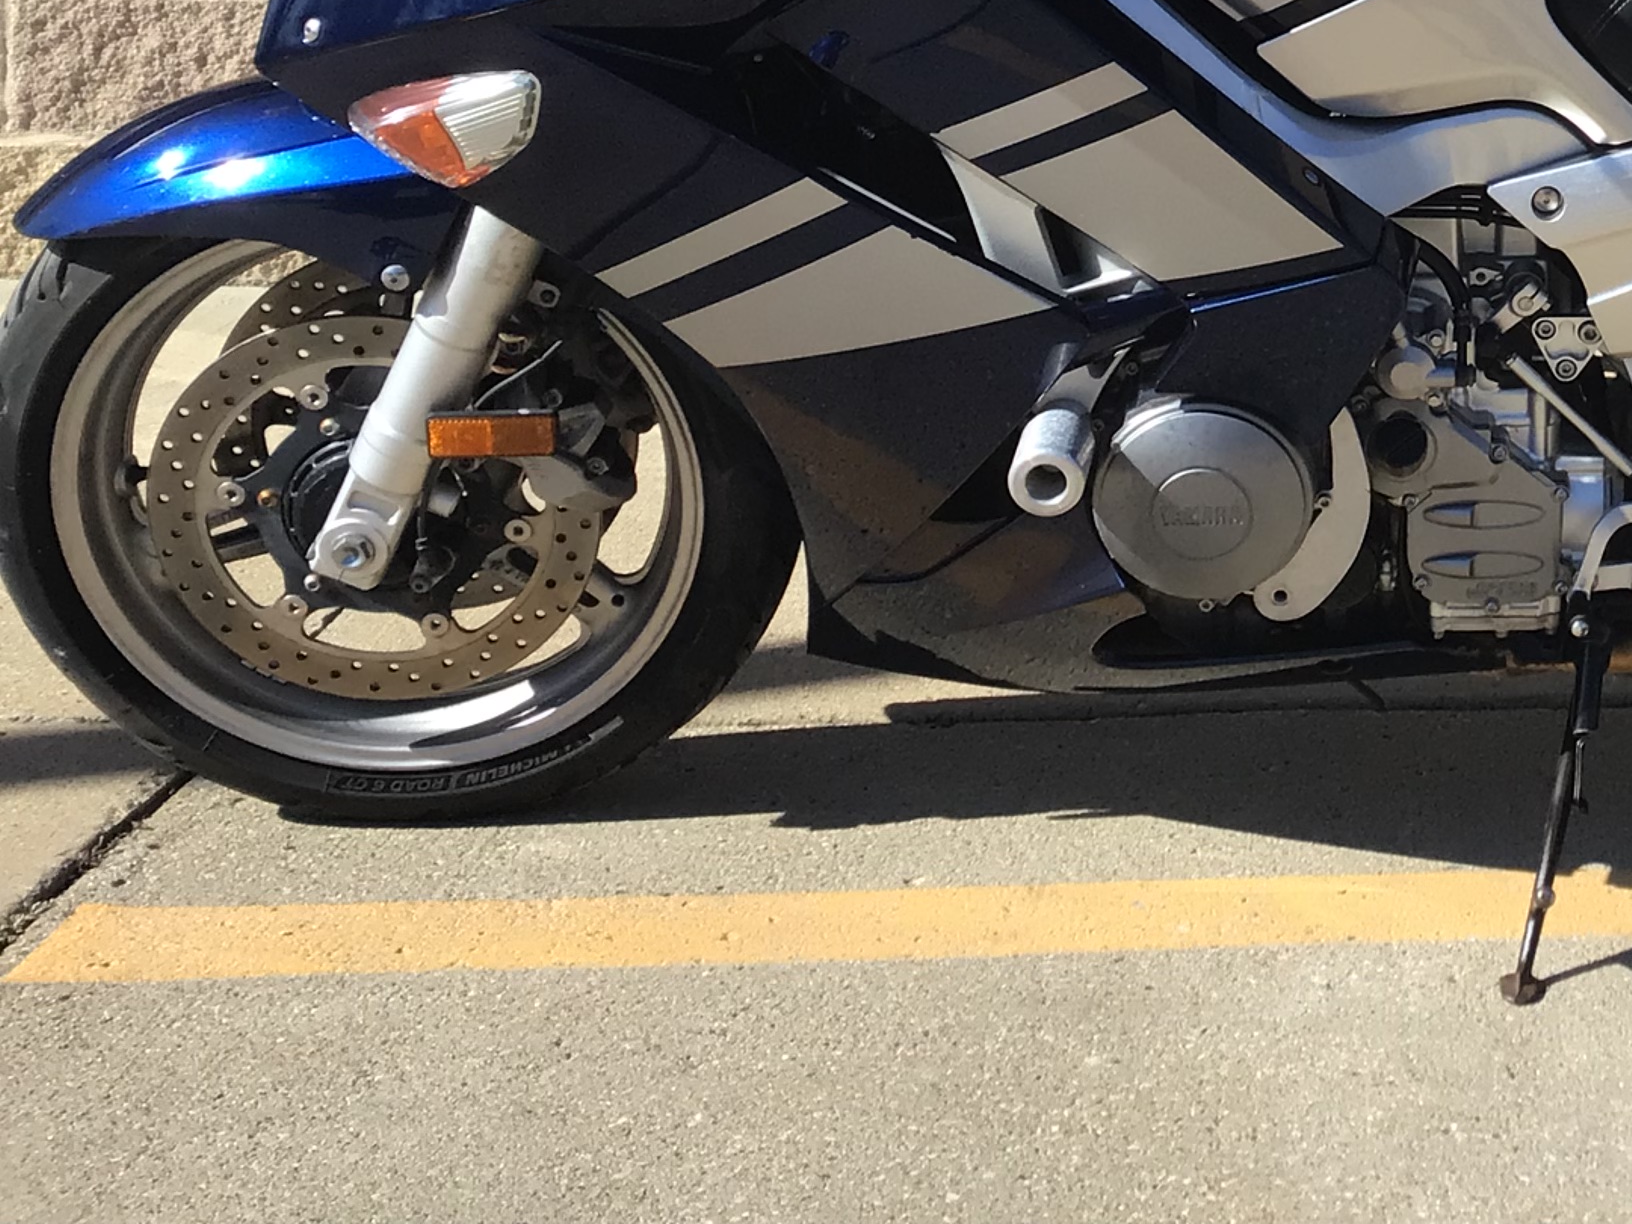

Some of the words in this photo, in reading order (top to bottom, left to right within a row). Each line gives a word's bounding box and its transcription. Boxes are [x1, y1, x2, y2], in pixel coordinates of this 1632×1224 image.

[465, 750, 558, 786] MICHELIN
[372, 778, 386, 792] 6
[391, 777, 445, 792] ROAD
